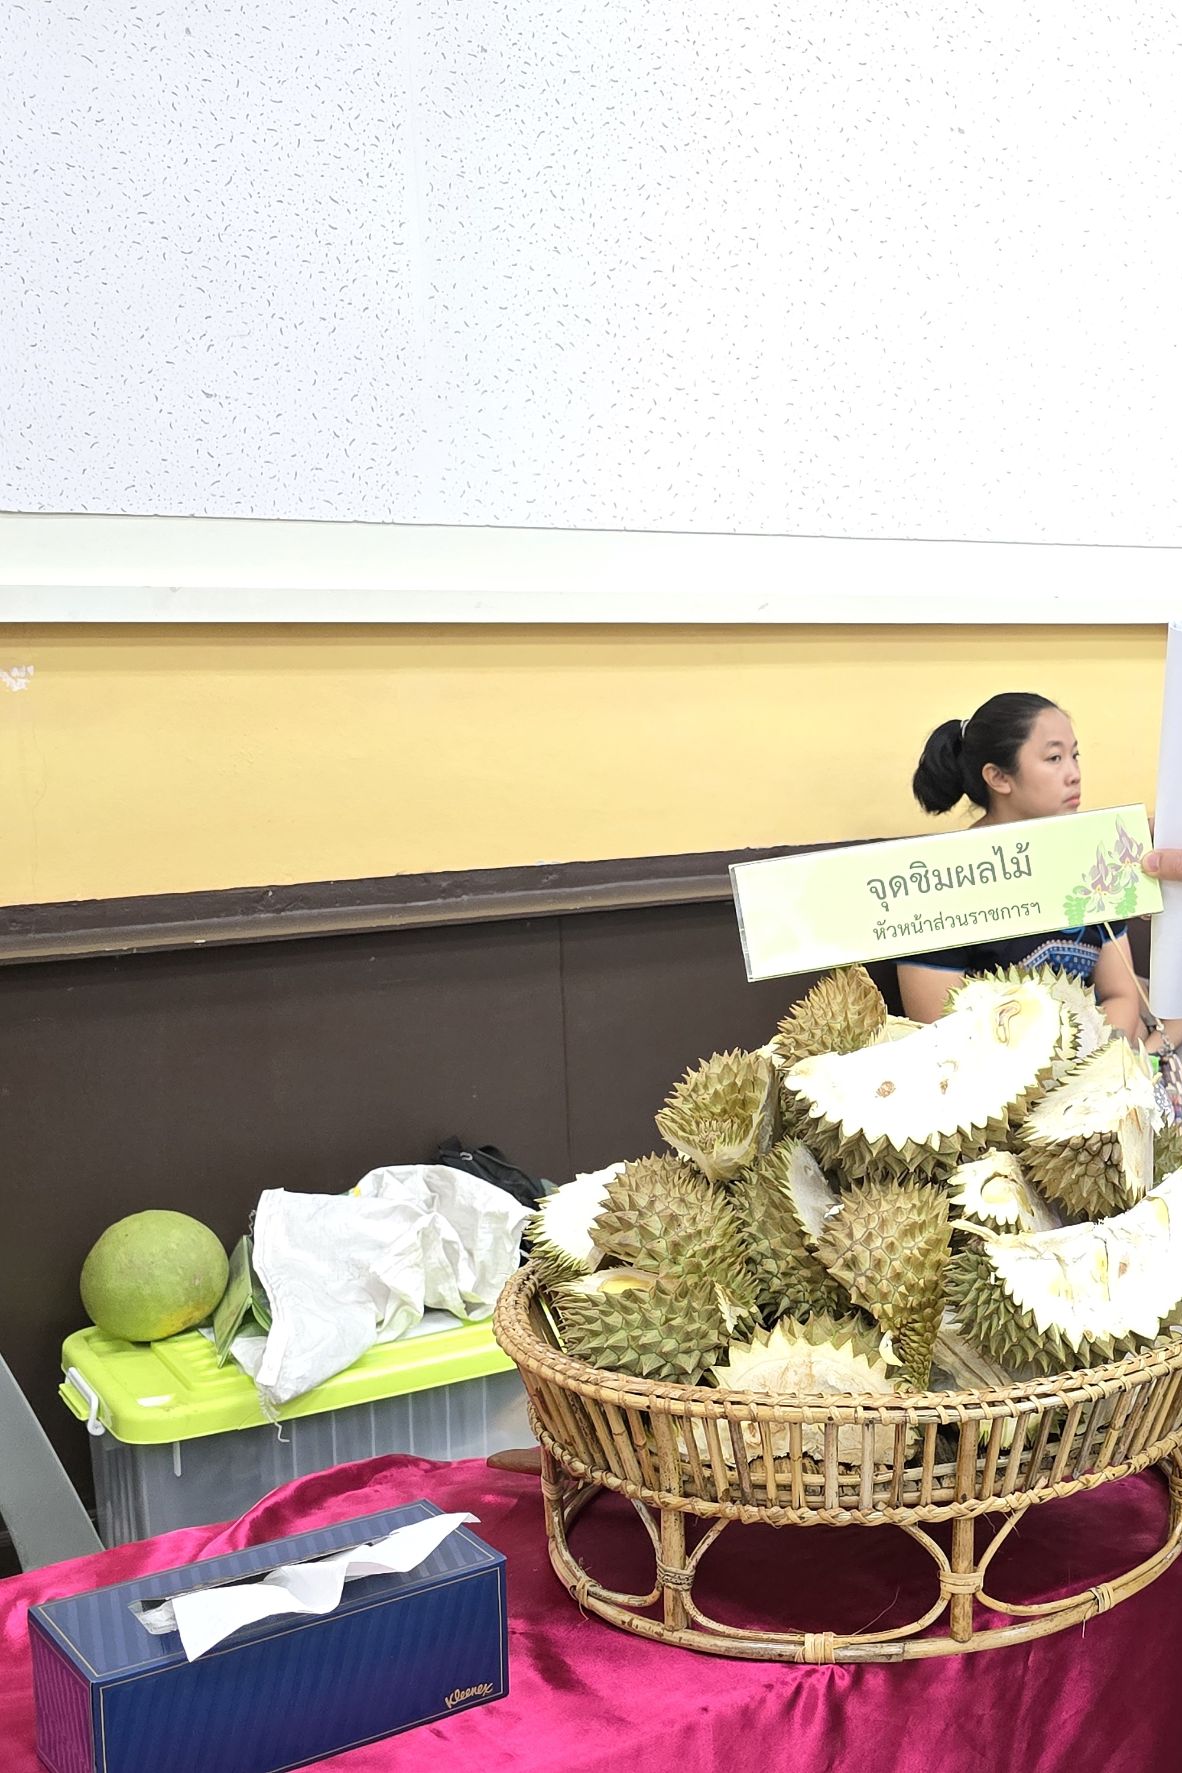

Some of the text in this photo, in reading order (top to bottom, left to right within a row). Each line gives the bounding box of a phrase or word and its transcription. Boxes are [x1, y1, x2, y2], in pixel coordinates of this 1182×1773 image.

[867, 841, 1032, 912] จุดชิมผลไม้
[873, 900, 1041, 940] หัวหน้าส่วนราชการฯ
[444, 1682, 494, 1709] Kleenex
